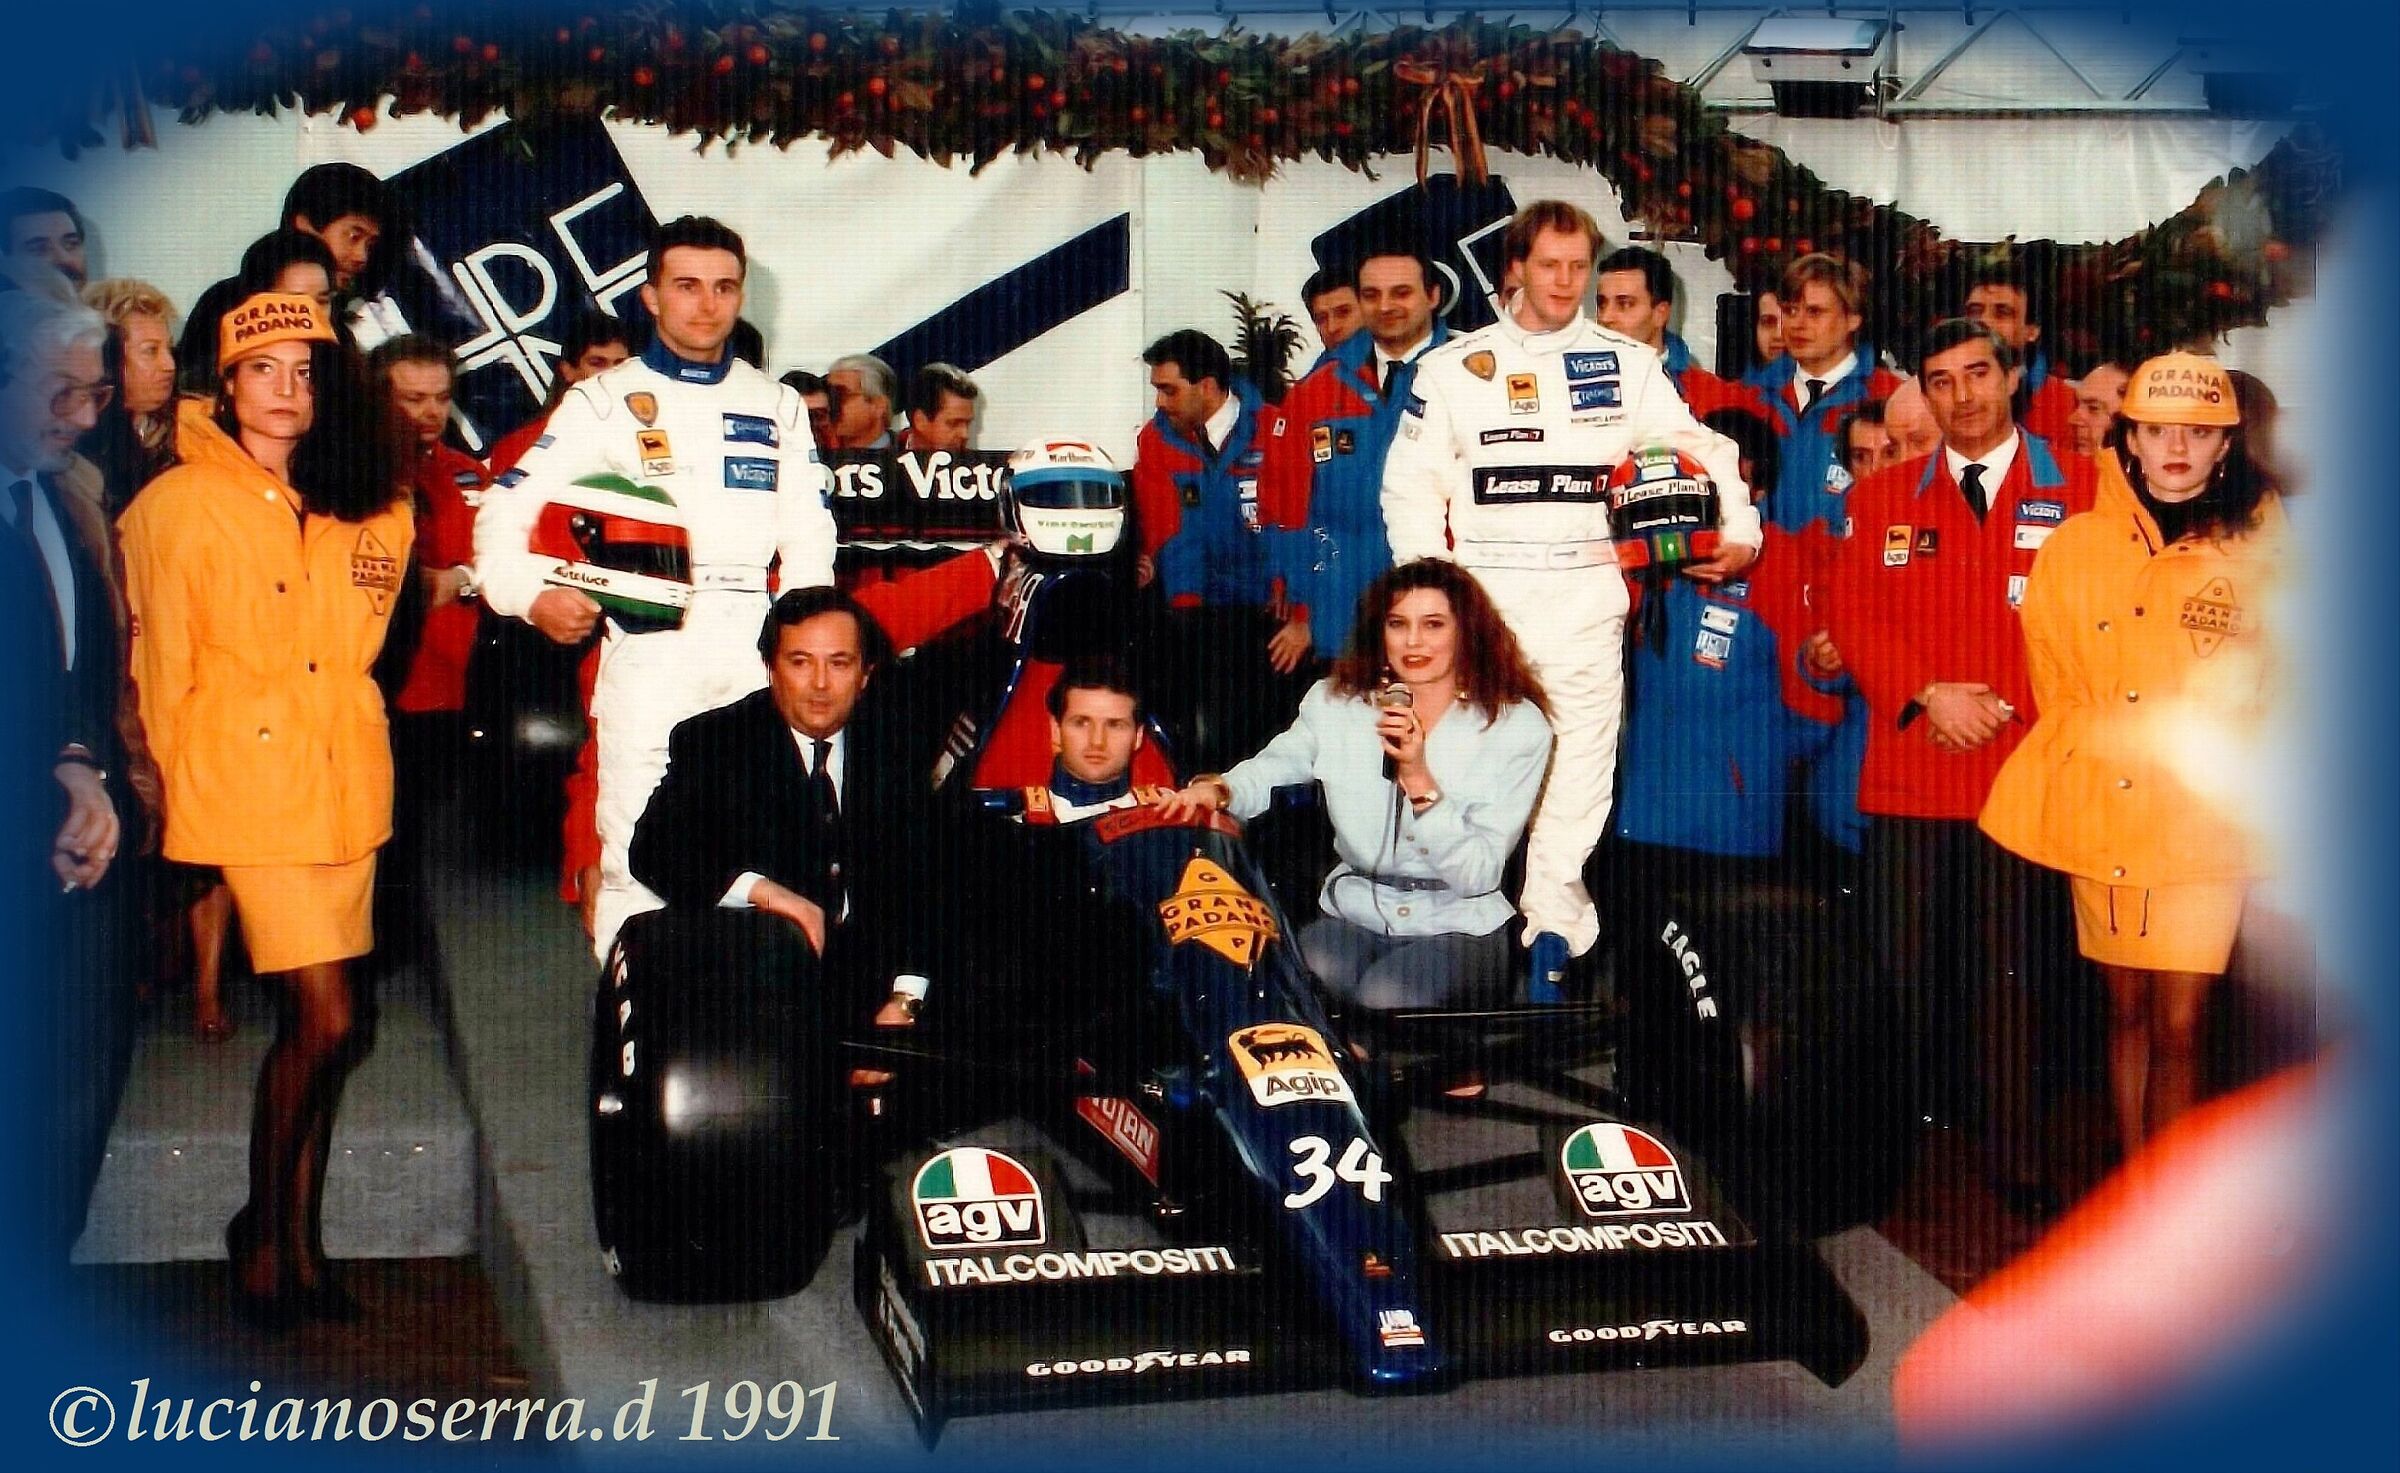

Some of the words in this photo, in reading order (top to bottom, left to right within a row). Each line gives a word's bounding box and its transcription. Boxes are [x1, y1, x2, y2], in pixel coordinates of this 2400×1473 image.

[234, 303, 311, 326] GRANA
[235, 318, 313, 342] PADANO
[2150, 368, 2220, 388] GRANA
[2148, 385, 2220, 403] PADANO
[1486, 476, 1540, 495] Lease
[1551, 475, 1592, 494] Plan
[1661, 921, 1717, 1020] EAGLE
[1267, 1072, 1341, 1096] Agip
[1284, 1135, 1392, 1209] 34
[1579, 1171, 1677, 1209] agv
[926, 1200, 1034, 1241] agv
[1441, 1221, 1729, 1257] ITALCOMPOSITI
[925, 1247, 1236, 1286] ITALCOMPOSITI
